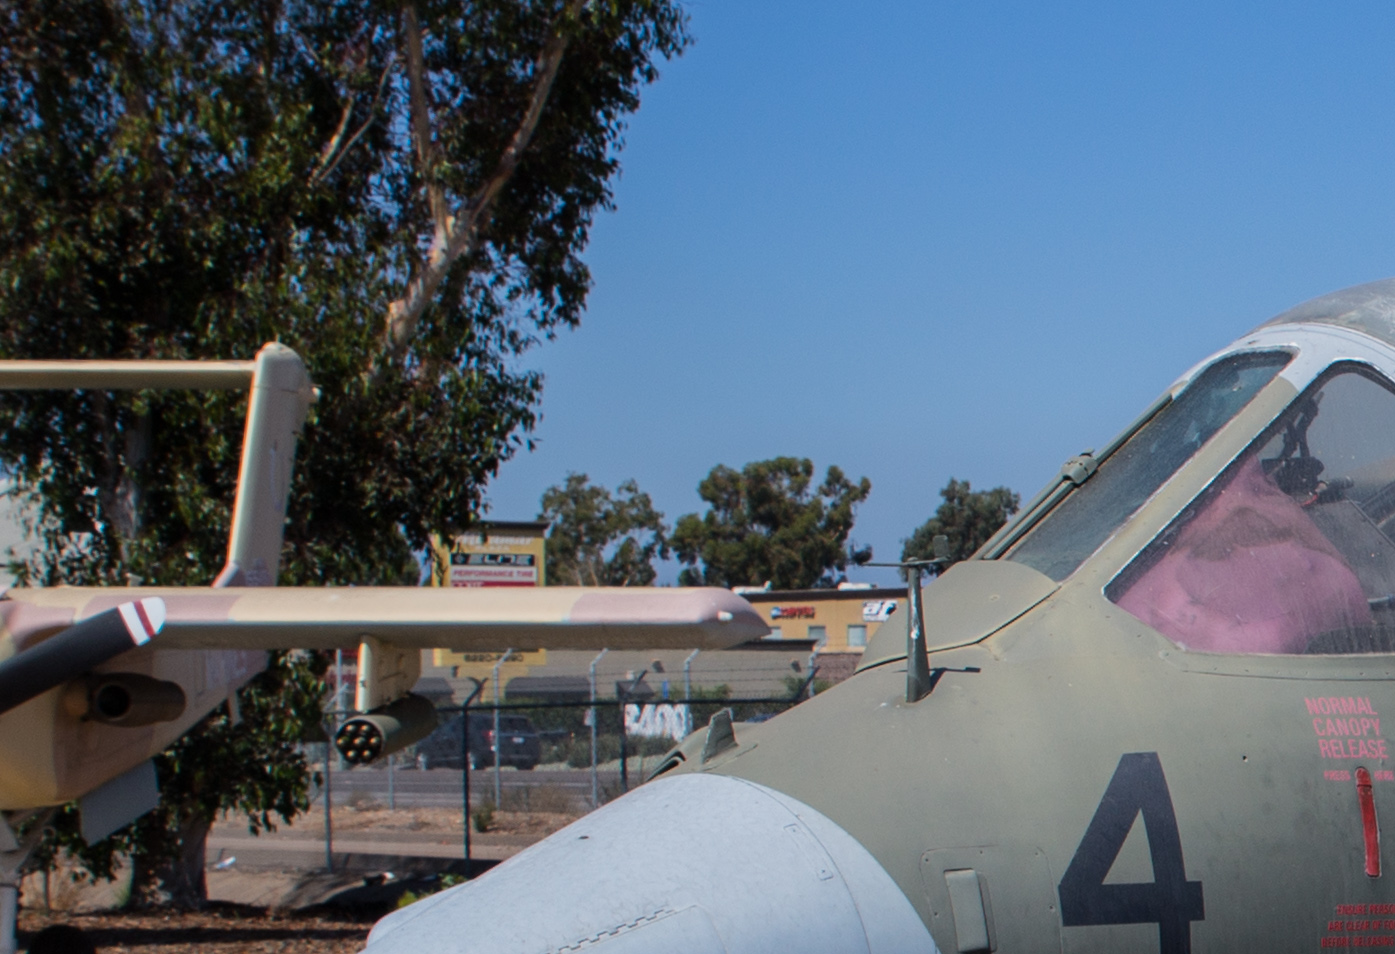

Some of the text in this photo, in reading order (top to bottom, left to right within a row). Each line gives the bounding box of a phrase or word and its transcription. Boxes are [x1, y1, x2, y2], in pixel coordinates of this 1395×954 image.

[1304, 696, 1378, 716] NORMAL
[1312, 717, 1381, 737] CANOPY
[1318, 738, 1389, 759] RELEASE
[1323, 769, 1351, 782] PRESS
[1336, 903, 1367, 916] ENSURE
[1327, 920, 1344, 932] ARE
[1346, 920, 1370, 931] CLEAR
[1371, 919, 1381, 931] OF
[1321, 936, 1350, 949] BEFORE
[1352, 935, 1395, 948] RELEASING
